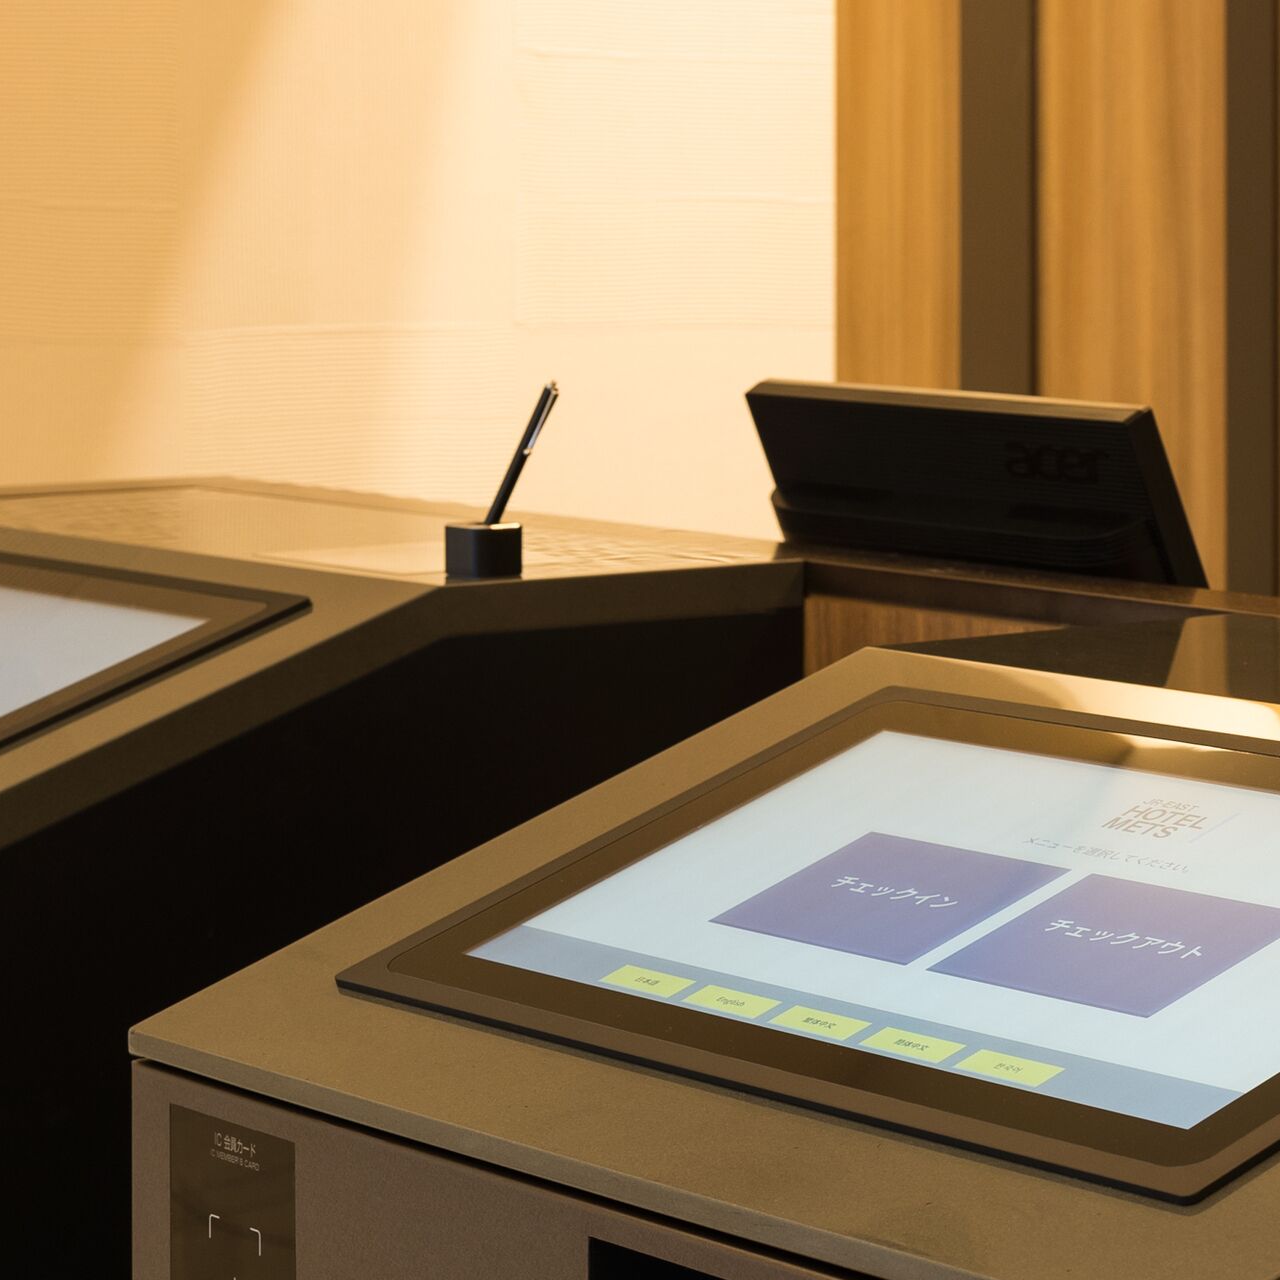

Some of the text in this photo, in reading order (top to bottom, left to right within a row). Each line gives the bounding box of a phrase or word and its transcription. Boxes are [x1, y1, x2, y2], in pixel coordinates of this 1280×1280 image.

[1006, 441, 1108, 484] acer
[1101, 816, 1179, 839] METS
[1121, 804, 1208, 830] HOTEL
[830, 875, 959, 909] チェックイン
[1045, 919, 1204, 960] チェックアウト
[715, 995, 746, 1007] English
[223, 1135, 257, 1158] 会員カード
